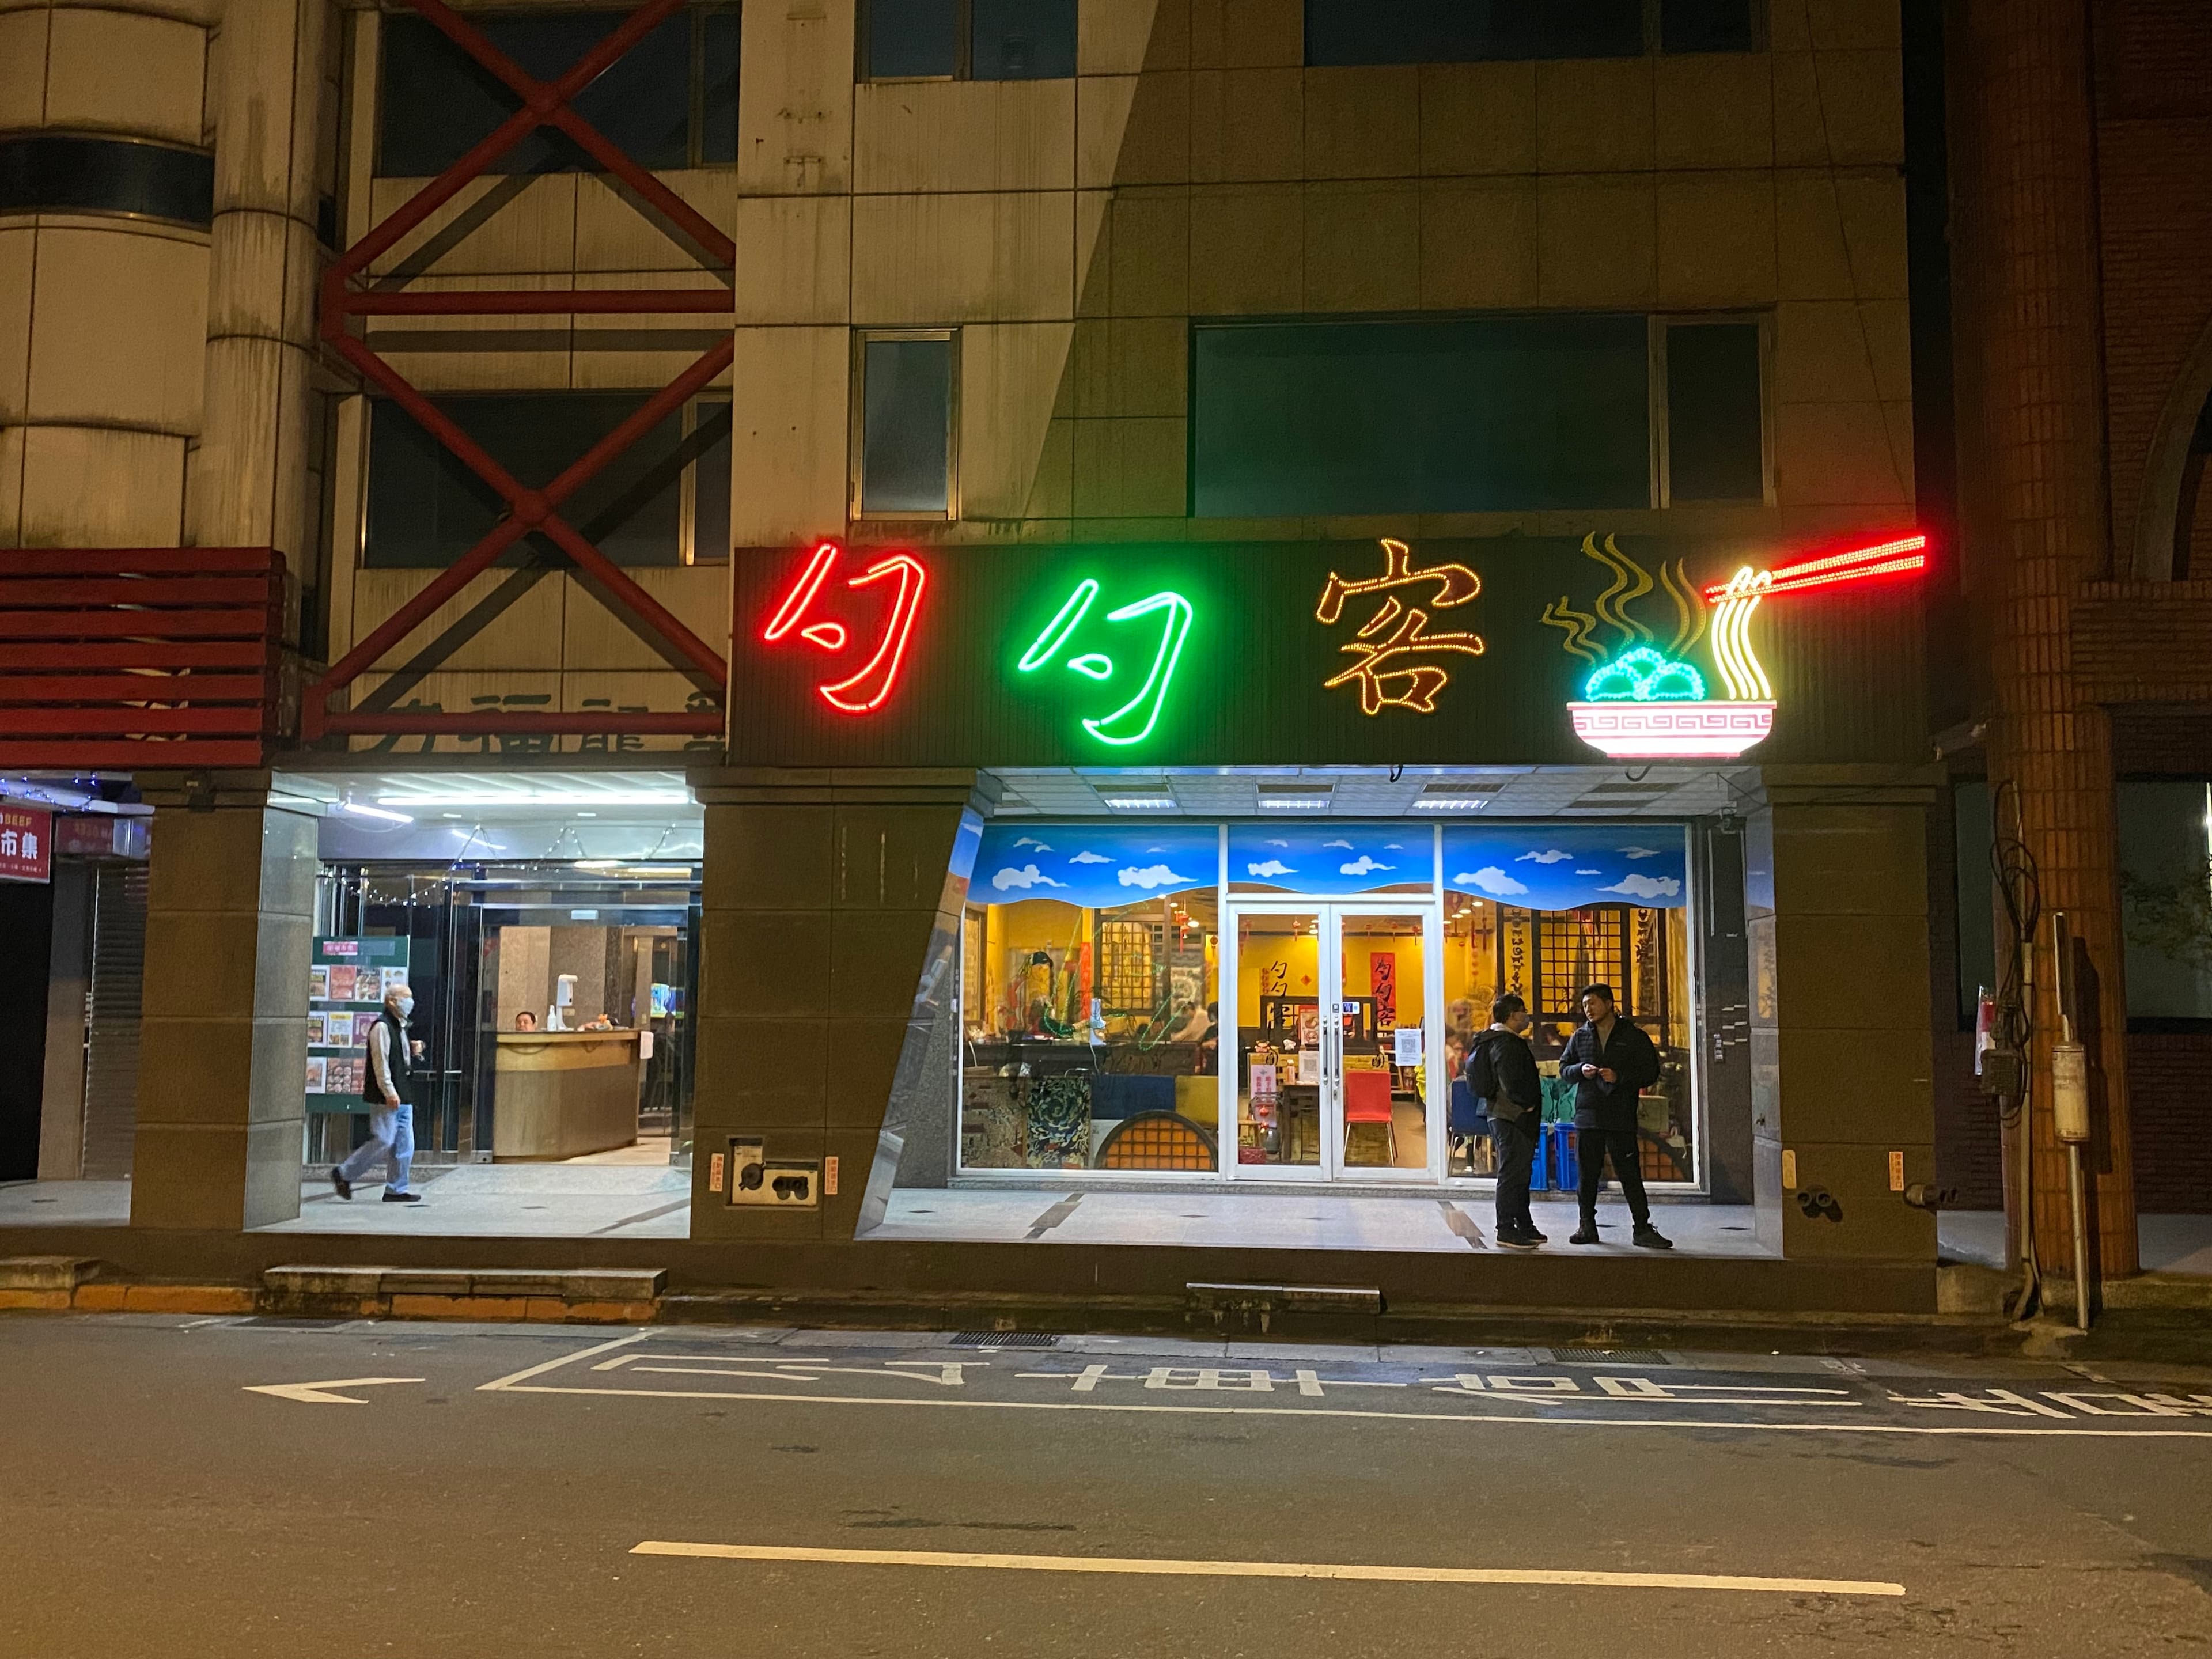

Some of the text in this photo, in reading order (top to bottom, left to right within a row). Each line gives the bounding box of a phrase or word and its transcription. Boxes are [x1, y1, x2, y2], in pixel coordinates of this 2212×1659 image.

[764, 538, 1484, 746] 勺勺客
[5, 813, 32, 827] BEEF
[1, 829, 38, 860] 市集
